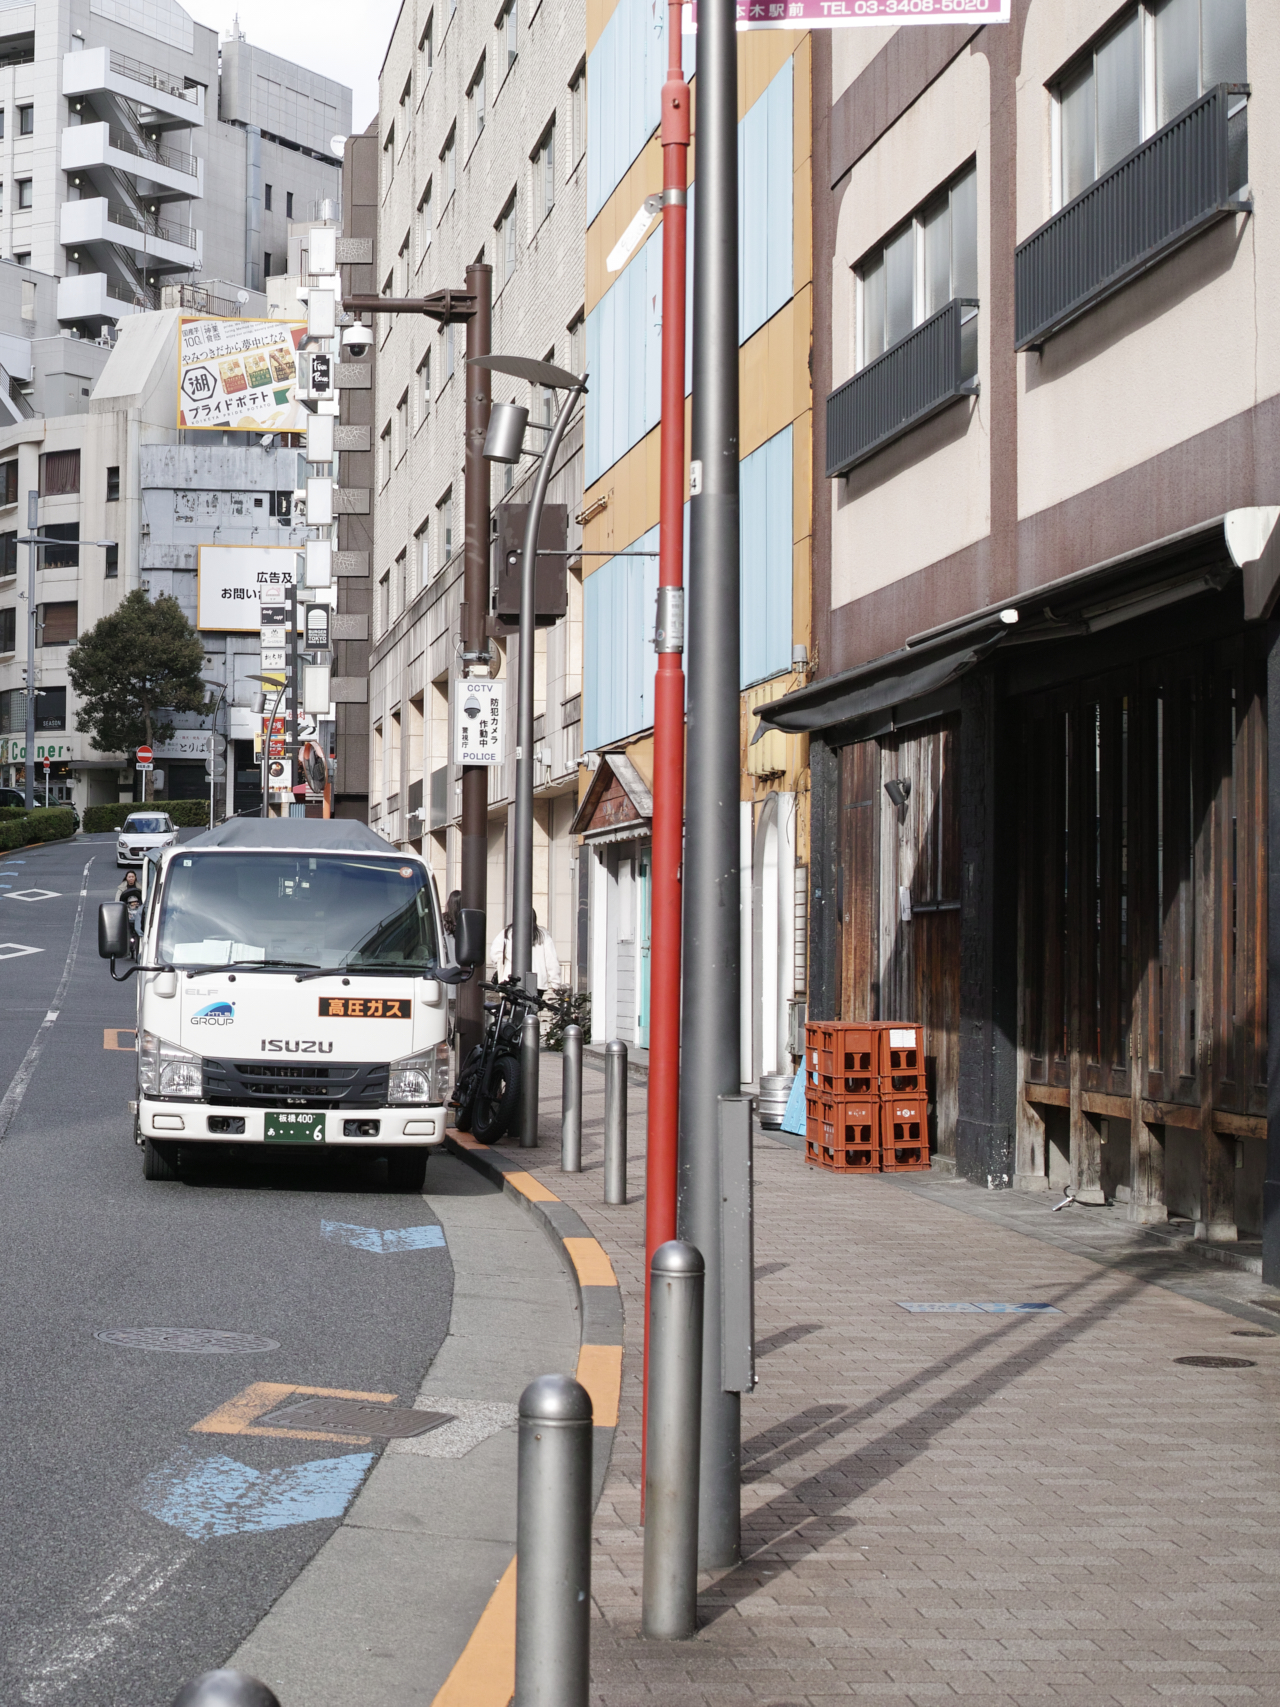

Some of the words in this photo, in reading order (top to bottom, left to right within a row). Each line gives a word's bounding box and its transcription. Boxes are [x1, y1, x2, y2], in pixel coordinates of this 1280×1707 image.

[822, 2, 852, 15] TEL
[182, 331, 286, 365] やみつきだから夢中になる
[188, 374, 211, 395] 湖
[189, 391, 269, 420] プライドポテト
[191, 415, 220, 425] KOIKEYA
[223, 408, 243, 418] PRIDE
[247, 402, 272, 412] POTATO
[467, 684, 493, 692] CCTV
[490, 698, 499, 744] 防犯カメラ
[479, 720, 488, 748] 作動中
[12, 741, 64, 760] Coner
[463, 752, 496, 760] POLICE
[328, 998, 402, 1017] 高圧ガス
[190, 1017, 234, 1026] GROUP
[261, 1039, 333, 1053] ISUZU
